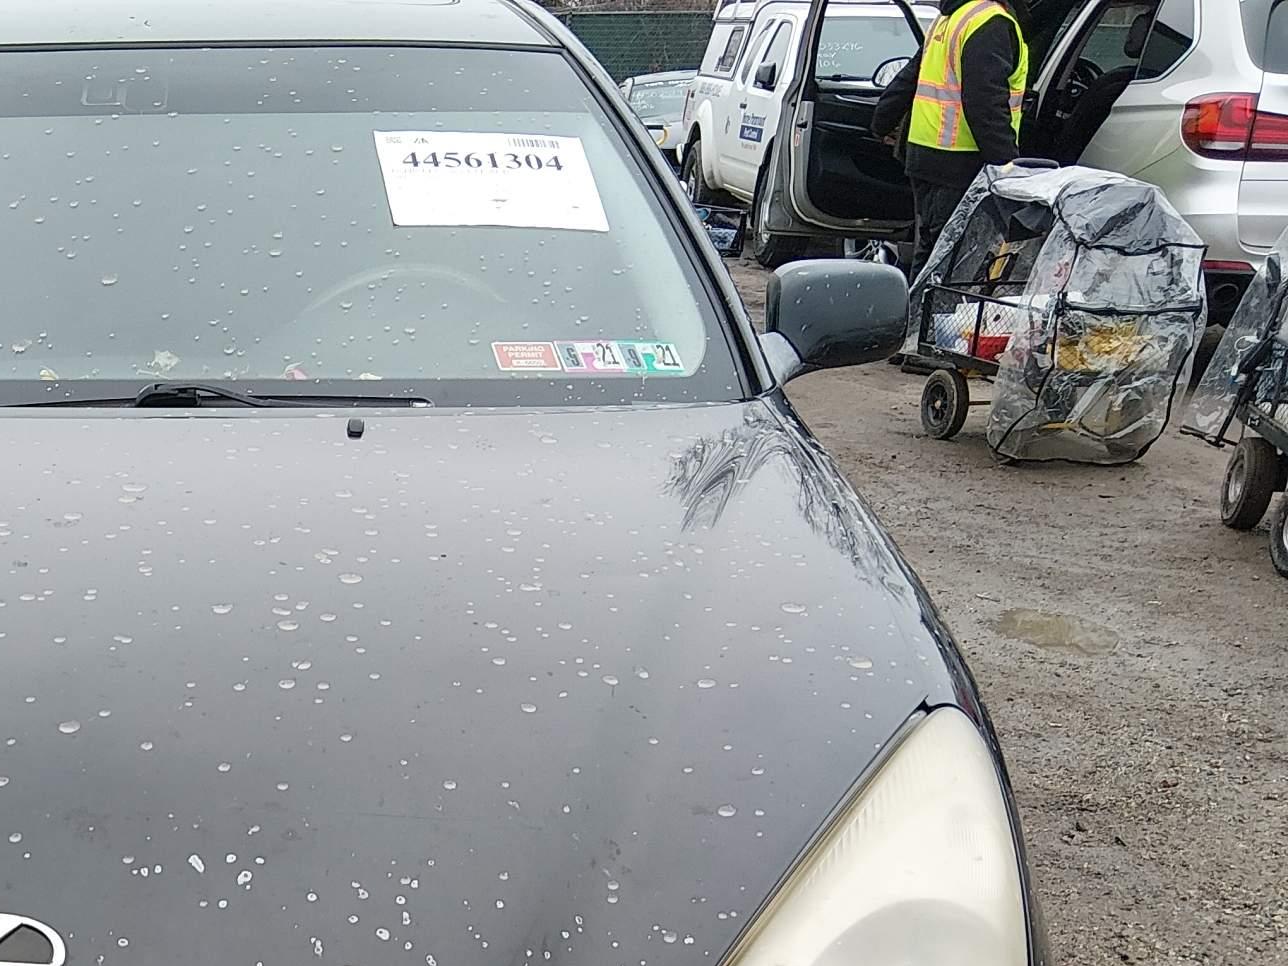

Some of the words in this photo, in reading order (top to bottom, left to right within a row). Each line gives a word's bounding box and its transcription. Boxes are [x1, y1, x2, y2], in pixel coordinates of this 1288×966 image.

[402, 151, 564, 172] 44561304
[508, 352, 544, 360] PERMIT
[596, 343, 620, 365] 21
[656, 344, 680, 367] 21
